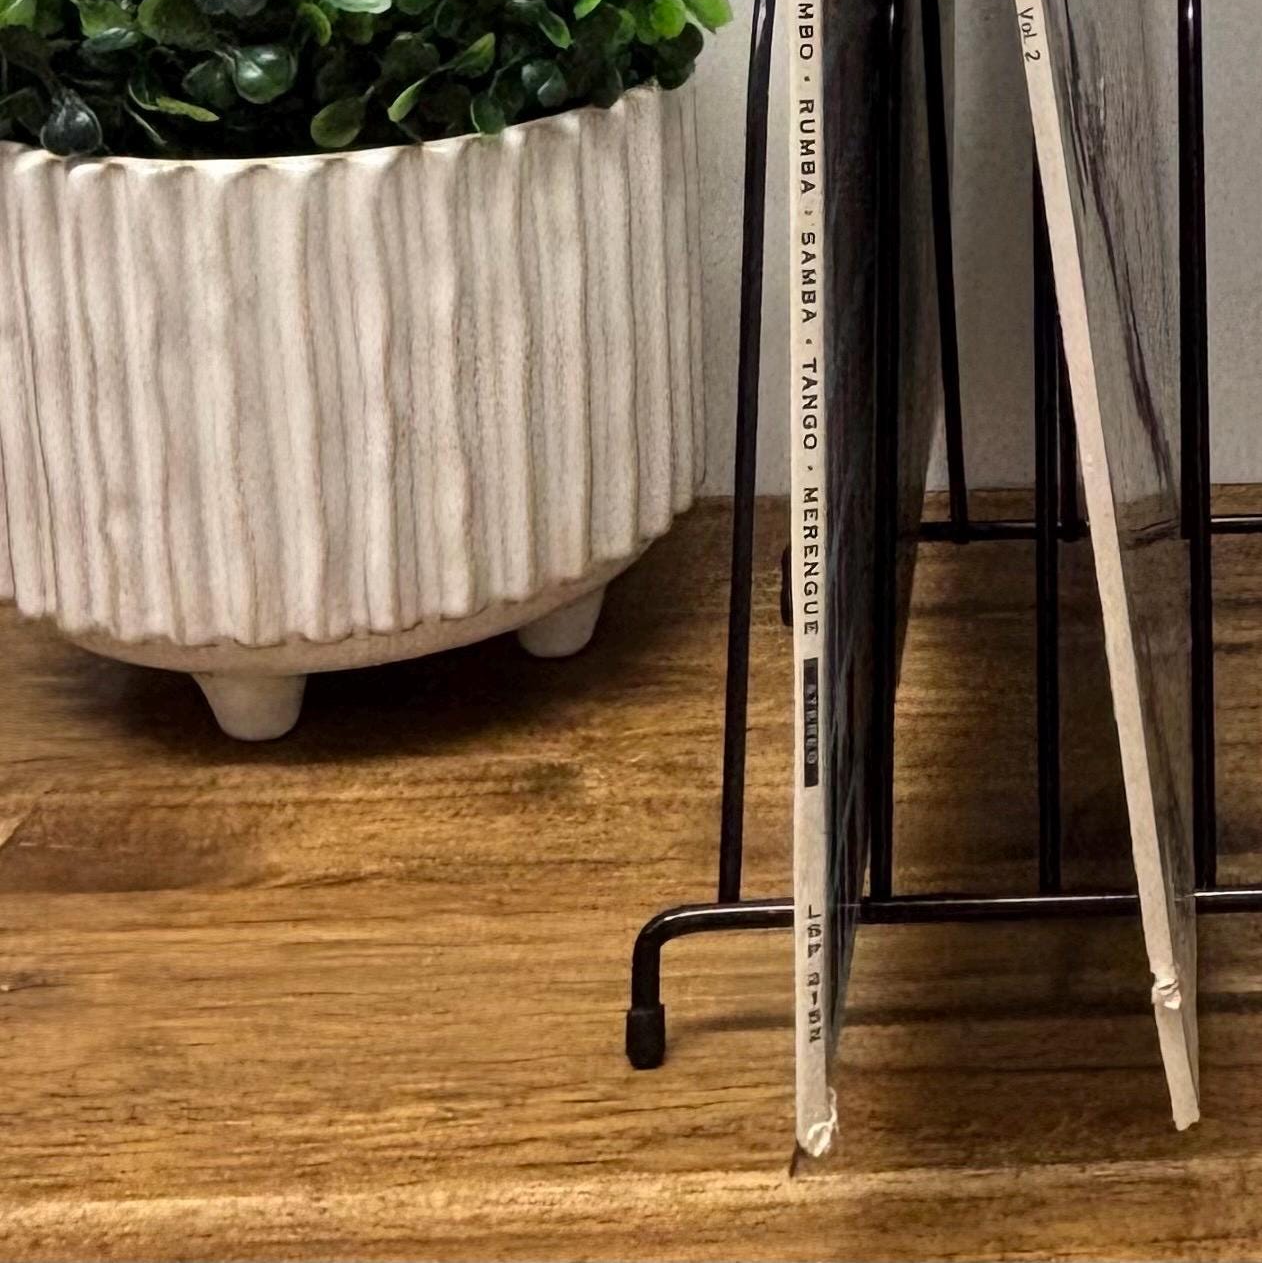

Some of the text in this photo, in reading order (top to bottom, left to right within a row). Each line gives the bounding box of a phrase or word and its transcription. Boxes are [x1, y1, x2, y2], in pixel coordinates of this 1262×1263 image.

[1023, 49, 1041, 64] 2
[799, 99, 816, 195] RUMBA
[801, 231, 818, 324] SAMBA
[802, 357, 819, 451] TANGO
[803, 487, 820, 636] MERENGUE
